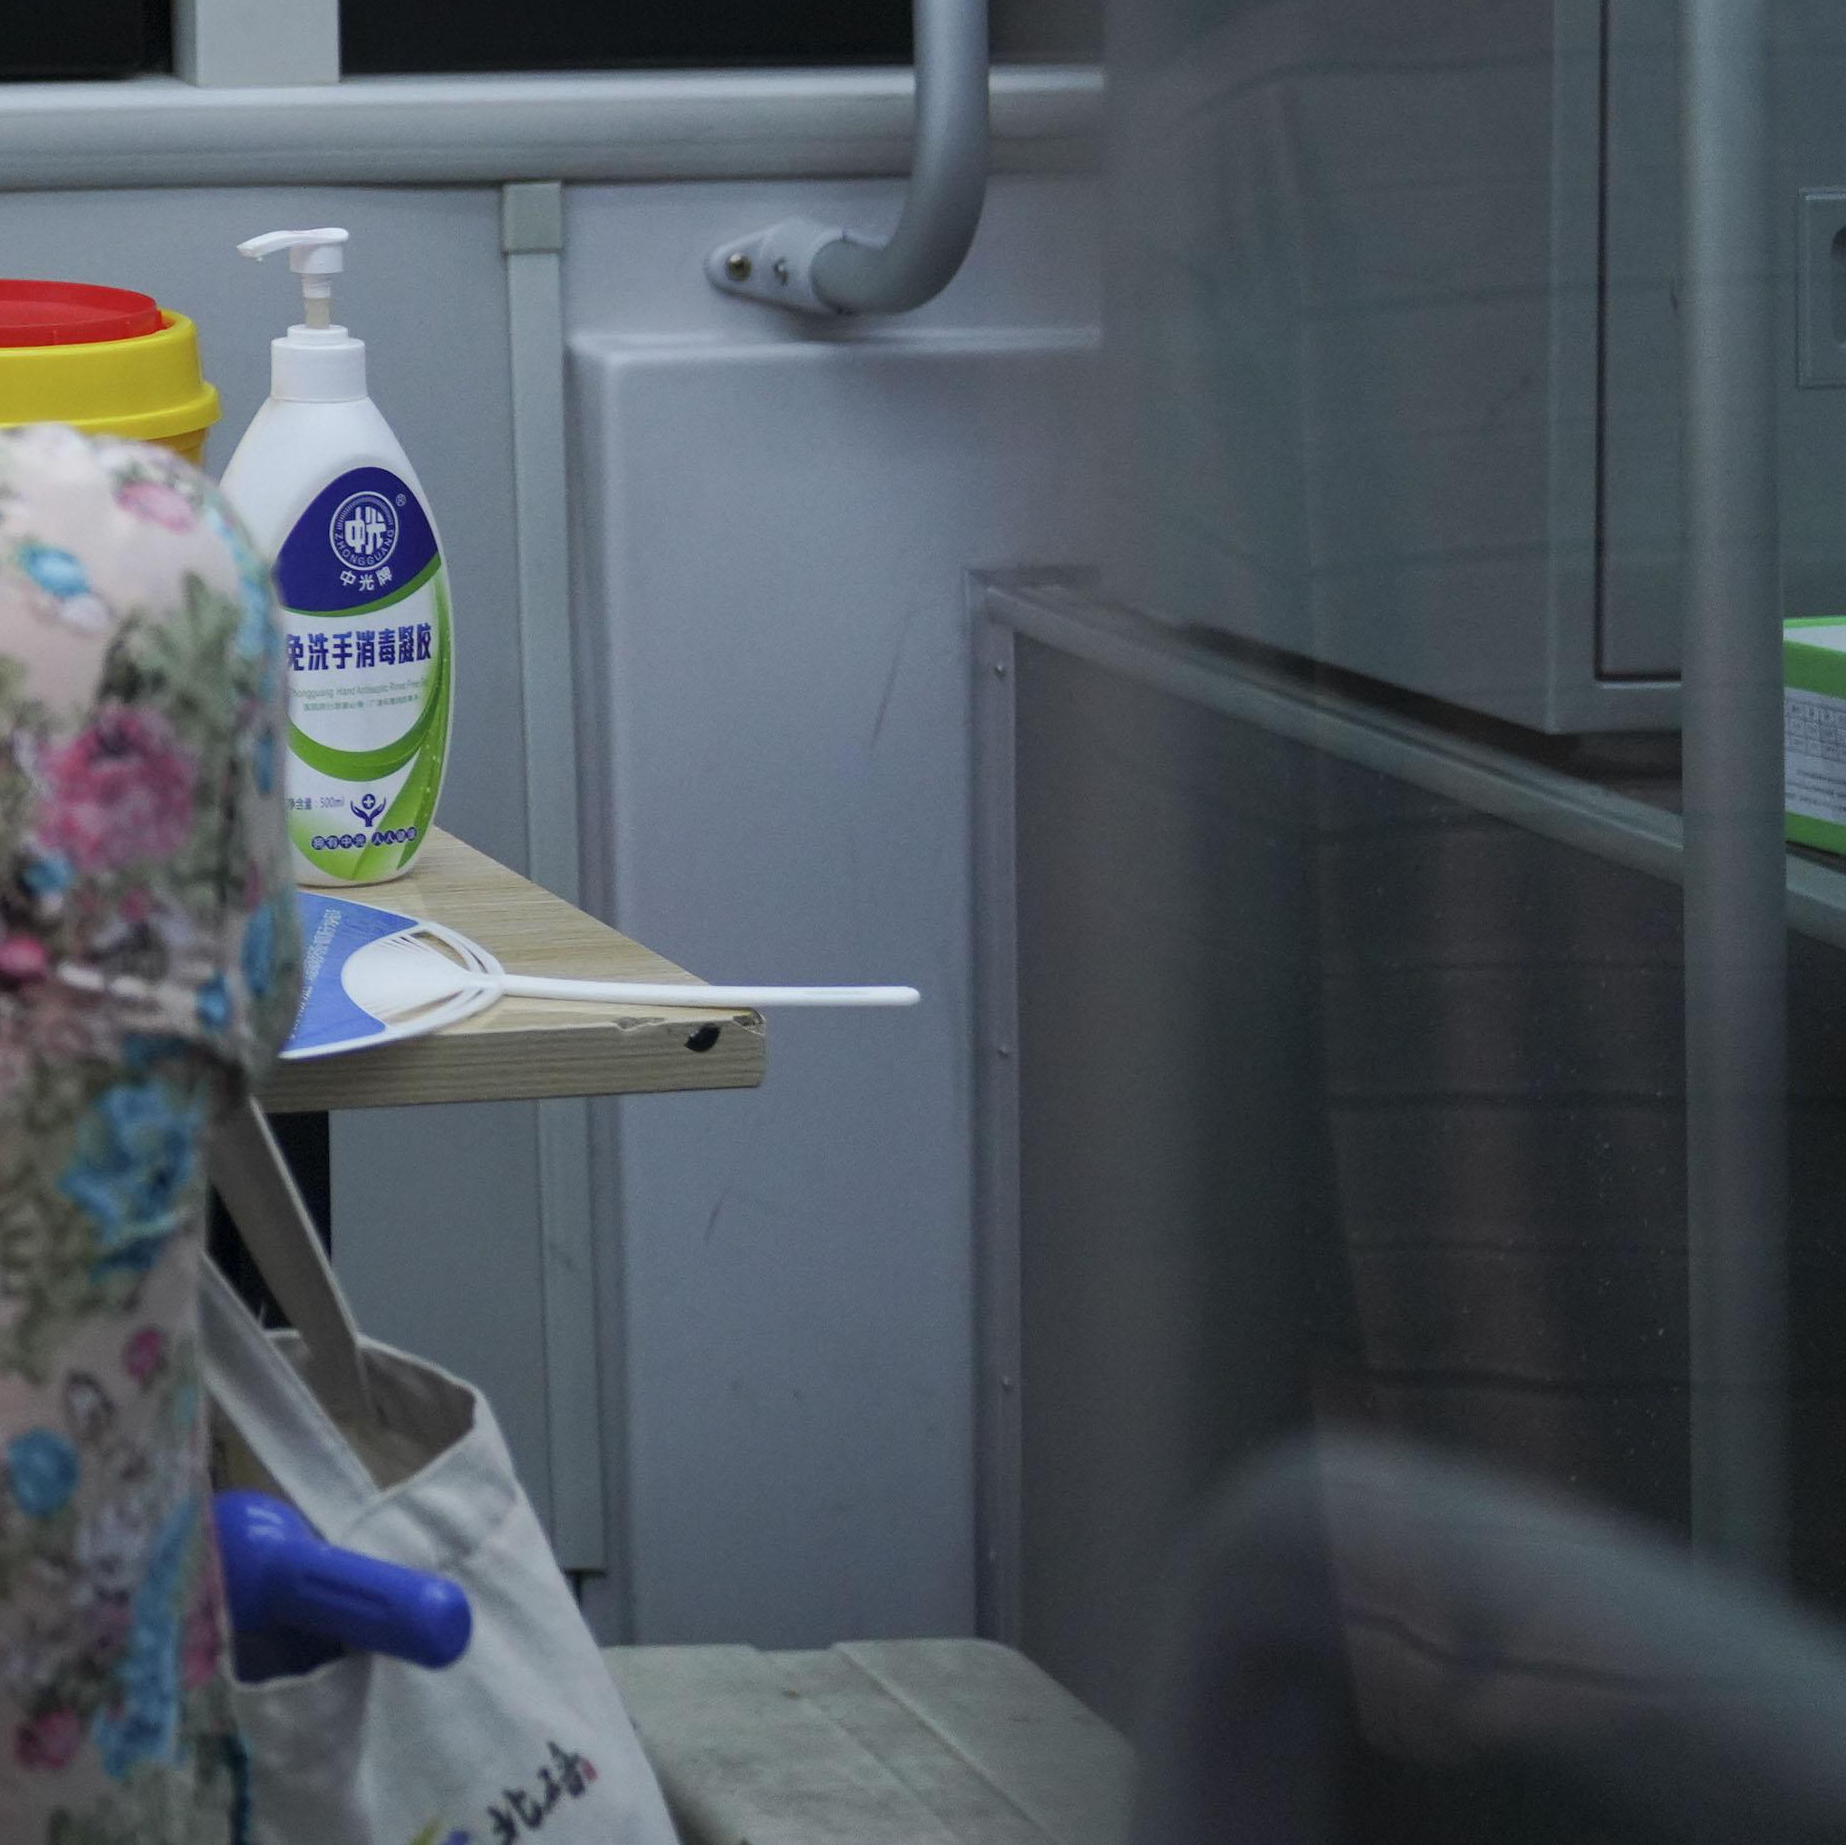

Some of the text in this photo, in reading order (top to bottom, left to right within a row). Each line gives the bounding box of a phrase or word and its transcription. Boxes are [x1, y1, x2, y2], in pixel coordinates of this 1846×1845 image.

[339, 566, 392, 592] 中光牌
[286, 622, 432, 672] 免洗手消毒凝胶
